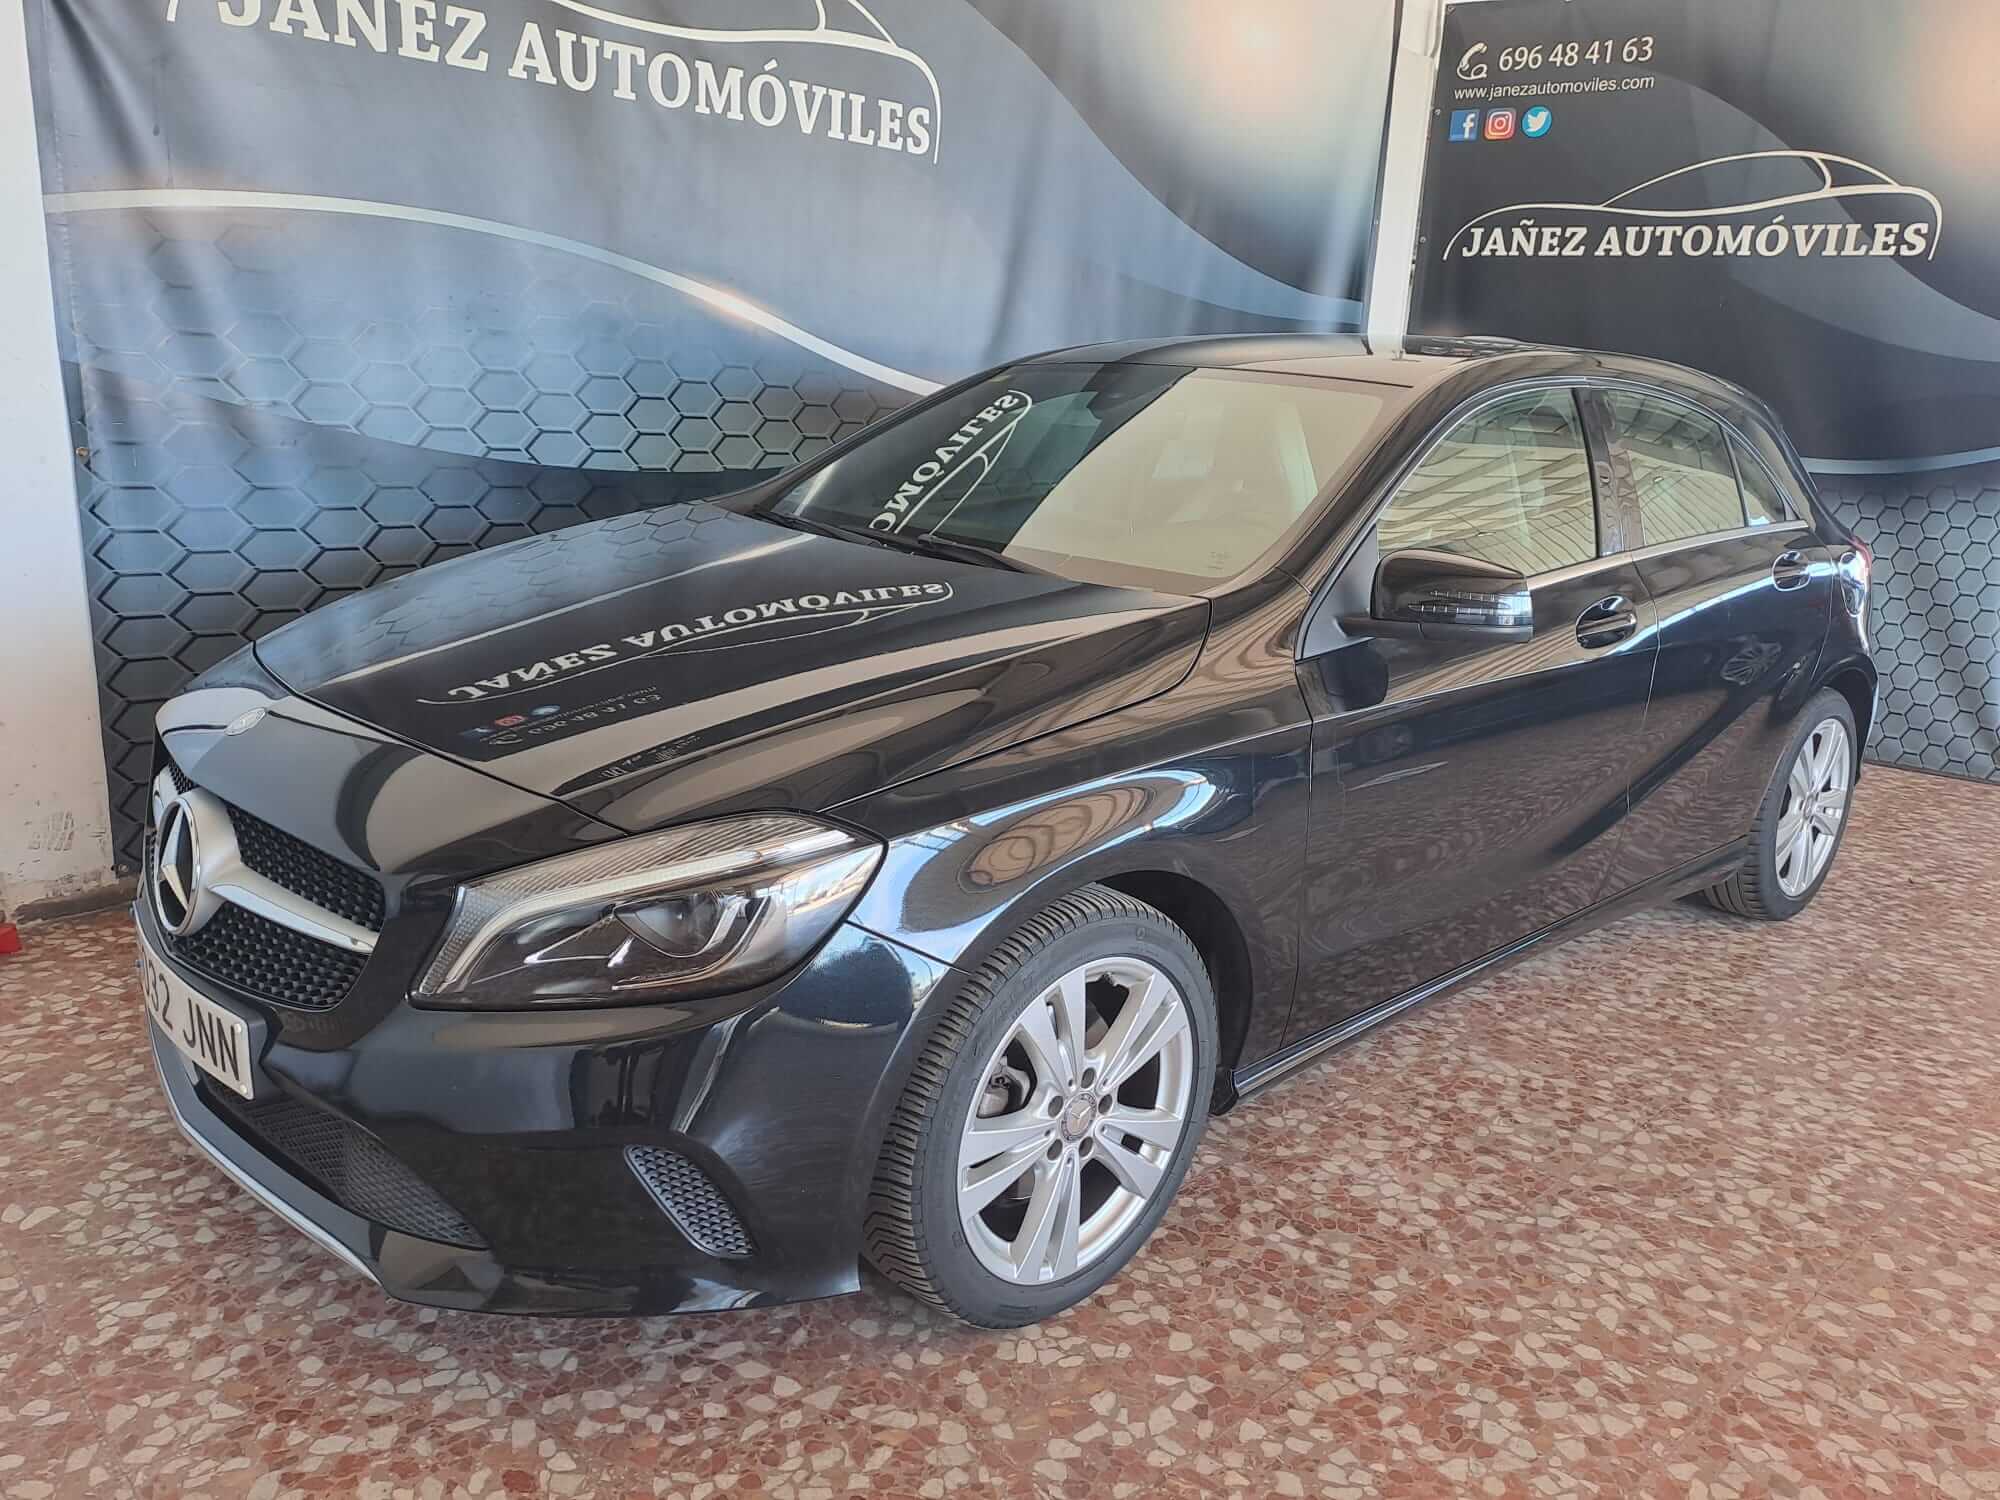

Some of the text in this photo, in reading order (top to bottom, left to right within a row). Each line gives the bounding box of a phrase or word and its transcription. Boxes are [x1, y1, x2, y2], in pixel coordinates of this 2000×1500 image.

[1499, 36, 1654, 71] 696 48 41 63
[508, 22, 930, 154] AUTOMÓVILES
[1454, 75, 1655, 101] www.janezautomoviles.com
[1463, 214, 1929, 258] JAÑEZ AUTOMÓVILES
[182, 997, 240, 1082] JNN
